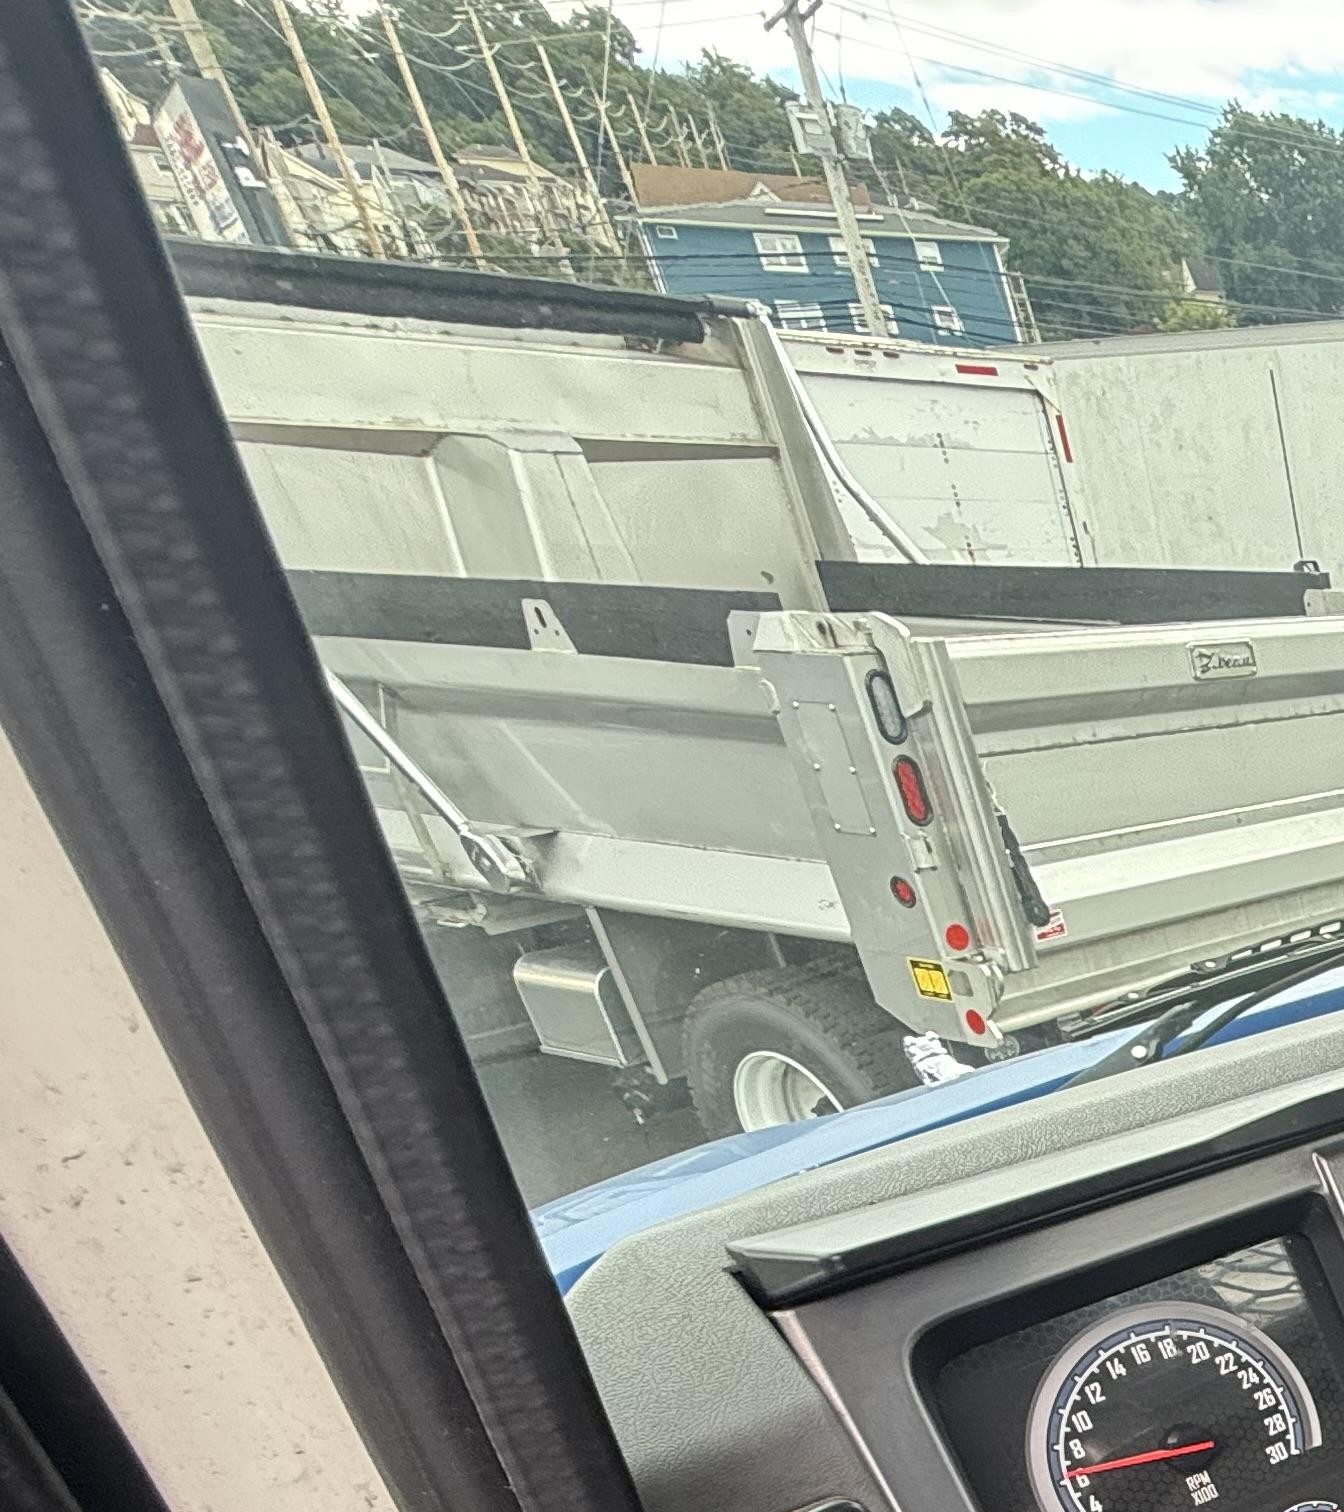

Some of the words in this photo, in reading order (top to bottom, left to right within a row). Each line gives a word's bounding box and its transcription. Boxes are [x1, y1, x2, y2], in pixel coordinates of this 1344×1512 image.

[1130, 1343, 1151, 1365] 16
[1157, 1337, 1178, 1360] 18
[1186, 1340, 1211, 1365] 20
[1105, 1357, 1127, 1380] 14
[1214, 1352, 1239, 1375] 22
[1237, 1367, 1260, 1390] 24
[1084, 1381, 1107, 1405] 12
[1253, 1387, 1277, 1411] 26
[1071, 1410, 1094, 1434] 10
[1263, 1413, 1287, 1437] 28
[1069, 1438, 1086, 1460] 8
[1265, 1441, 1289, 1465] 30
[1075, 1467, 1091, 1489] 6
[1185, 1470, 1212, 1492] RPM
[1088, 1495, 1103, 1512] 4
[1190, 1483, 1220, 1507] X100
